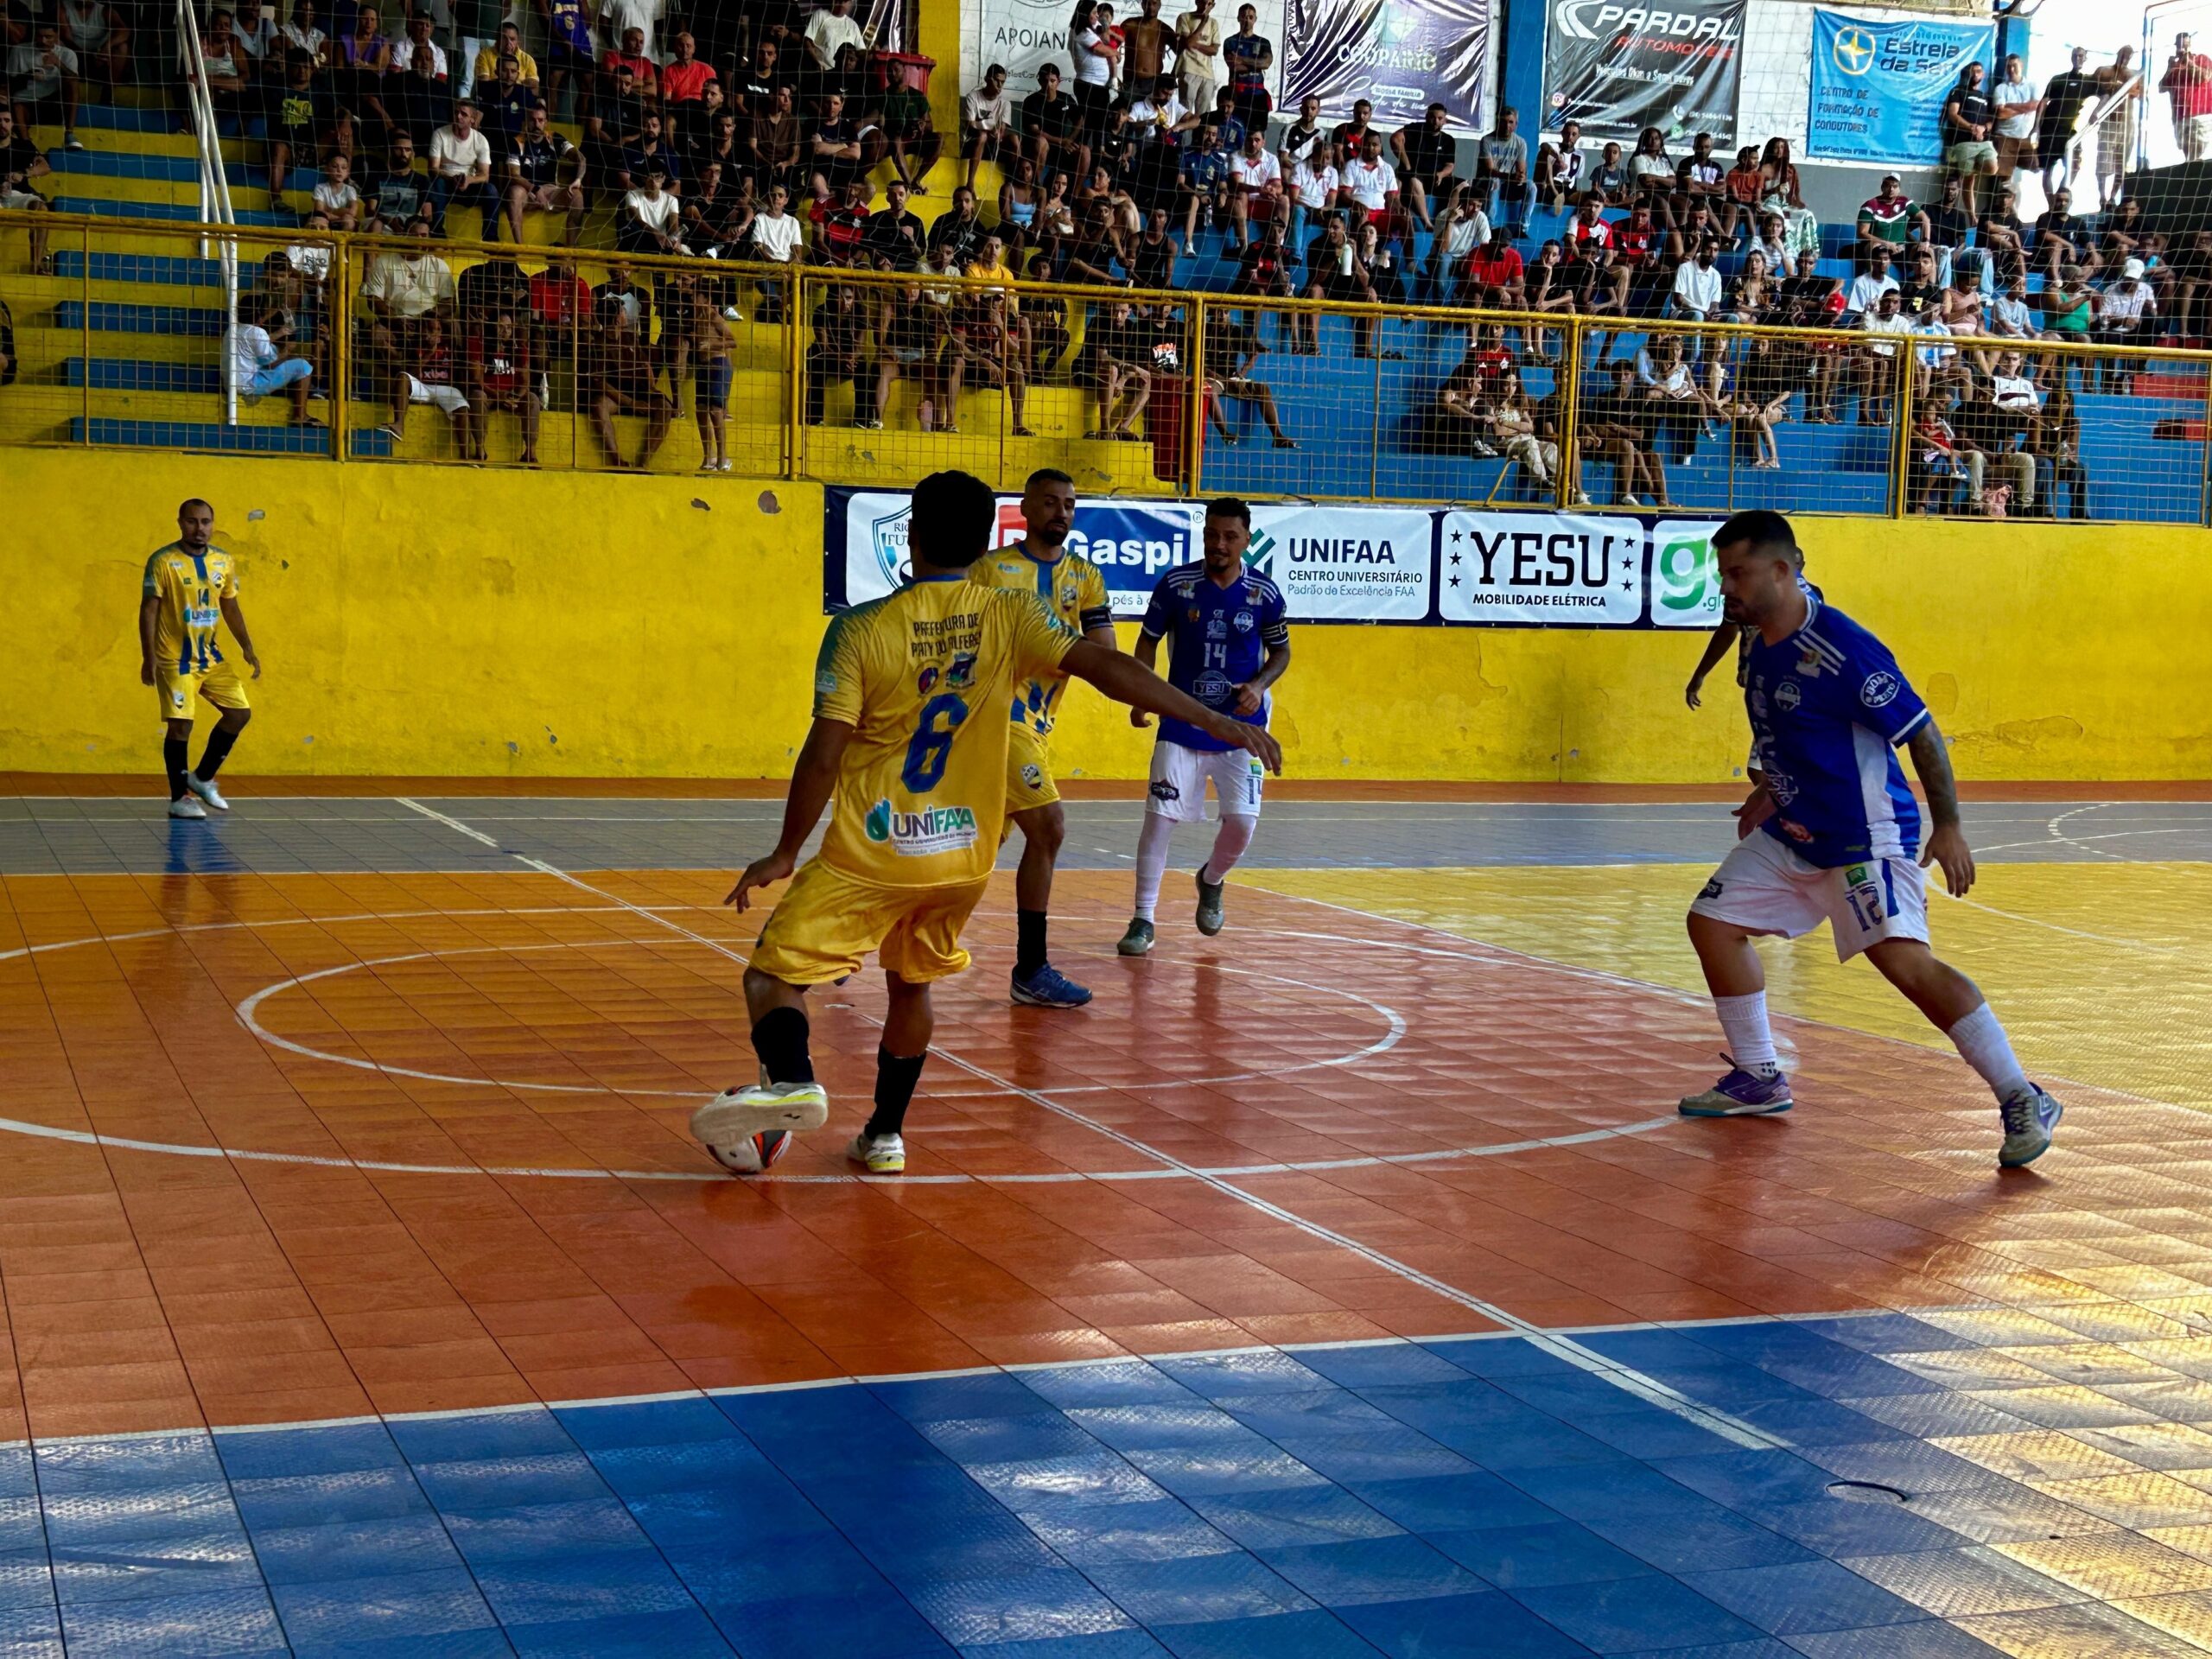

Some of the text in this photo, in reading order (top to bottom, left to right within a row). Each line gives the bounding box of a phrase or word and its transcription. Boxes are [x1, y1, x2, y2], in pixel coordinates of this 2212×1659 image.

[1593, 5, 1740, 41] PARDAL
[995, 27, 1066, 50] APOIAN
[1885, 37, 1961, 58] Estrela
[1880, 56, 1910, 73] da
[1820, 86, 1869, 100] CENTRO DE
[1867, 107, 1880, 118] DE
[1815, 119, 1868, 134] CONDUTORES
[1062, 529, 1185, 575] Gaspi
[1289, 538, 1395, 563] UNIFAA
[1471, 531, 1614, 588] YESU
[1288, 570, 1423, 583] CENTRO UNIVERSITÁRIO
[1660, 536, 1721, 610] g
[198, 588, 209, 607] 14
[1288, 584, 1415, 597] Padrão de Excelência FAA
[1473, 593, 1606, 607] MOBILIDADE ELÉTRICA
[1702, 594, 1725, 612] .gl
[967, 613, 979, 629] DE
[911, 642, 933, 657] PATY
[1204, 642, 1227, 669] 14
[1199, 683, 1225, 694] YESU
[901, 692, 969, 793] 6
